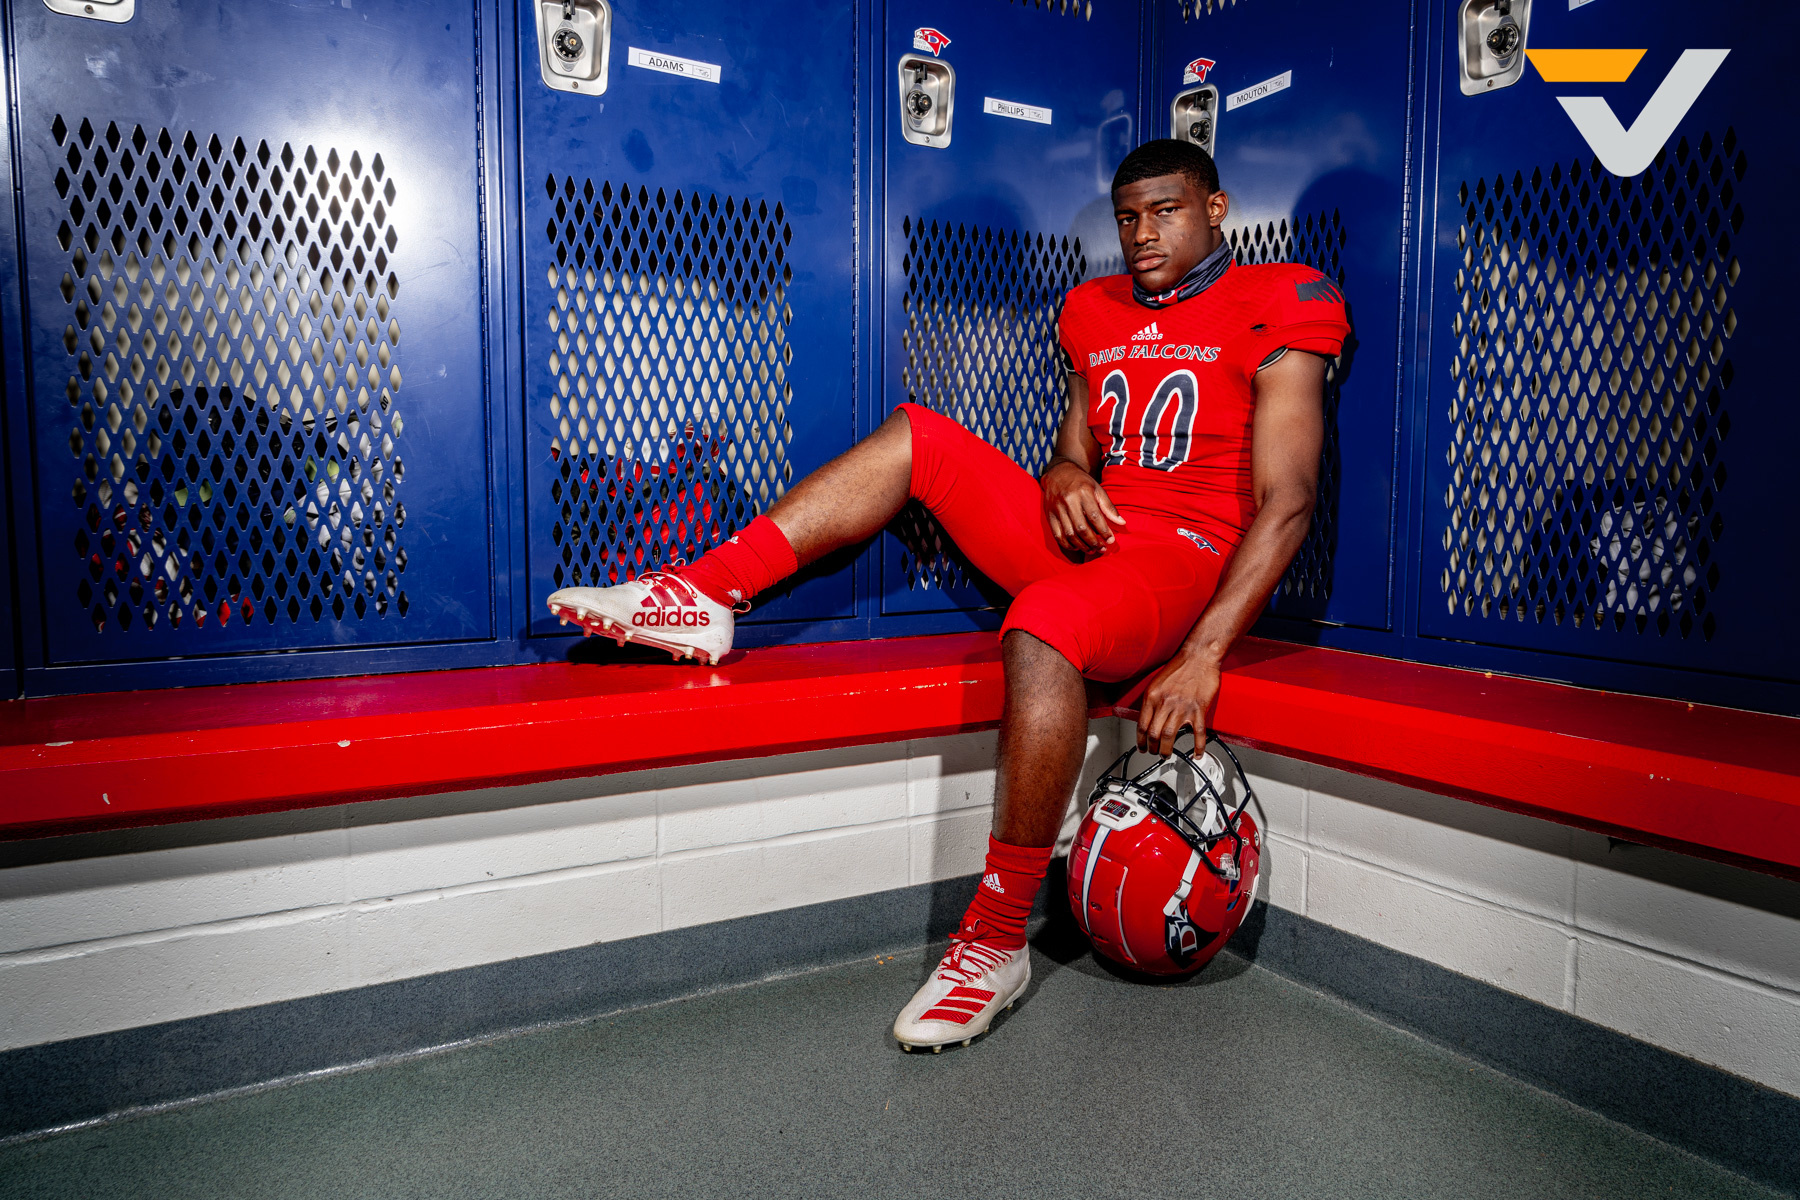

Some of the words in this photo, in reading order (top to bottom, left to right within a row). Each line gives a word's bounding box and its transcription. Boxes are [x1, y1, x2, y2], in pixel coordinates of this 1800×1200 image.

[648, 57, 684, 72] ADAMS
[1236, 84, 1268, 104] MOUTON
[997, 103, 1025, 116] PHILLIPS
[1131, 333, 1164, 341] adidas
[1089, 345, 1126, 367] DAVIS
[1128, 344, 1221, 362] FALCONS
[631, 606, 710, 626] adidas
